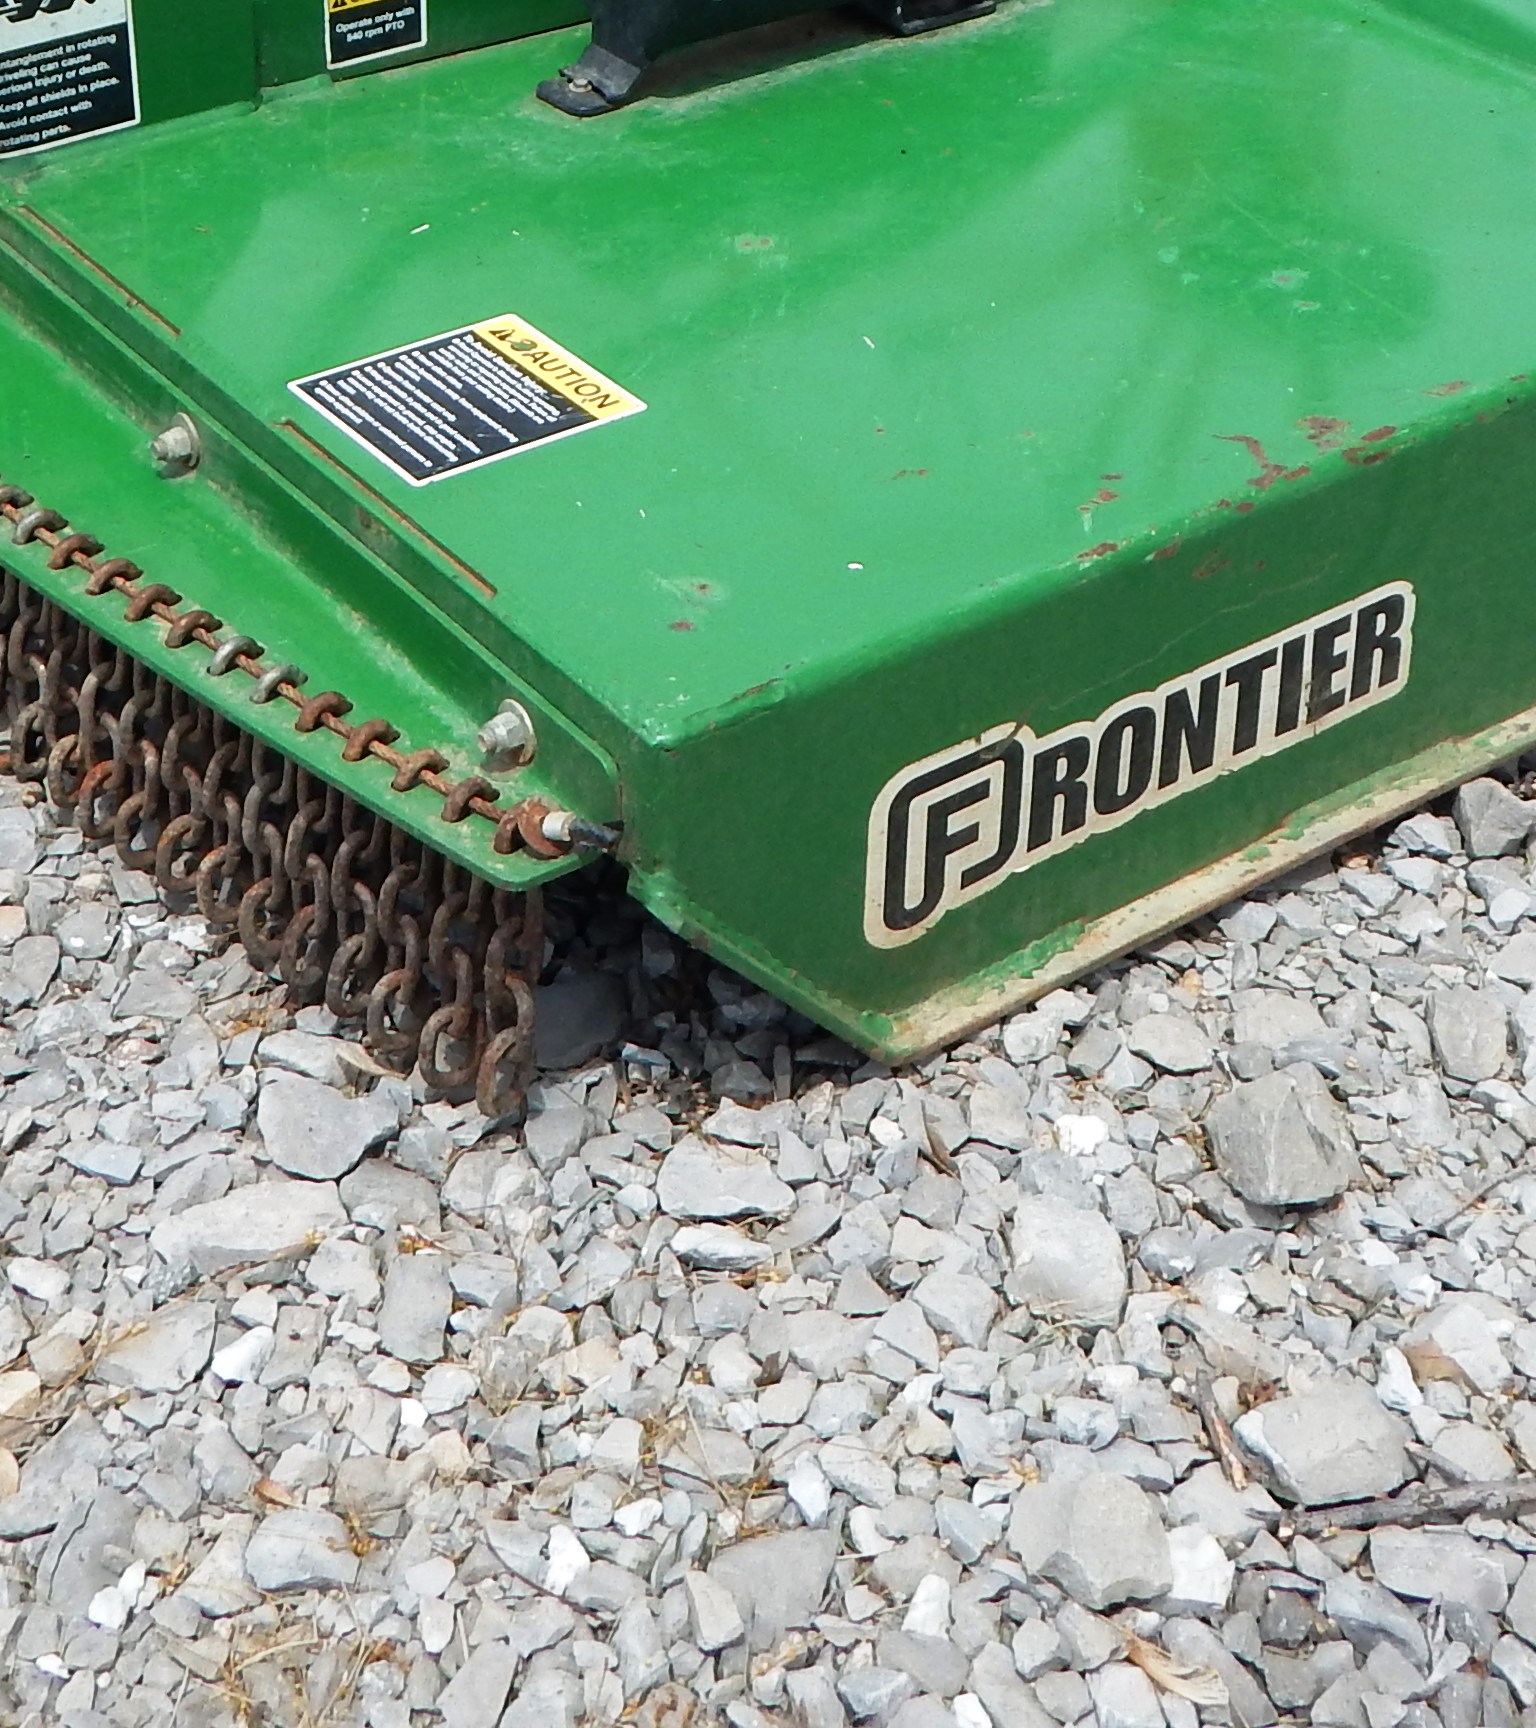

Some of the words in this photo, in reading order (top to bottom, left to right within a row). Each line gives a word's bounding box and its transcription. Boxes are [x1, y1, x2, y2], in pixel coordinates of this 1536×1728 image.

[335, 17, 373, 33] Operate
[374, 12, 394, 23] only
[365, 26, 384, 38] rpm
[385, 19, 405, 32] PTO
[65, 44, 75, 53] in
[77, 33, 117, 50] rotating
[40, 62, 59, 73] can
[61, 53, 92, 67] cause
[34, 73, 63, 88] injury
[65, 69, 77, 79] or
[26, 96, 38, 107] all
[40, 87, 77, 103] shields
[78, 83, 88, 93] in
[29, 106, 68, 123] contact
[70, 100, 93, 112] with
[882, 593, 1407, 932] FRONTIER
